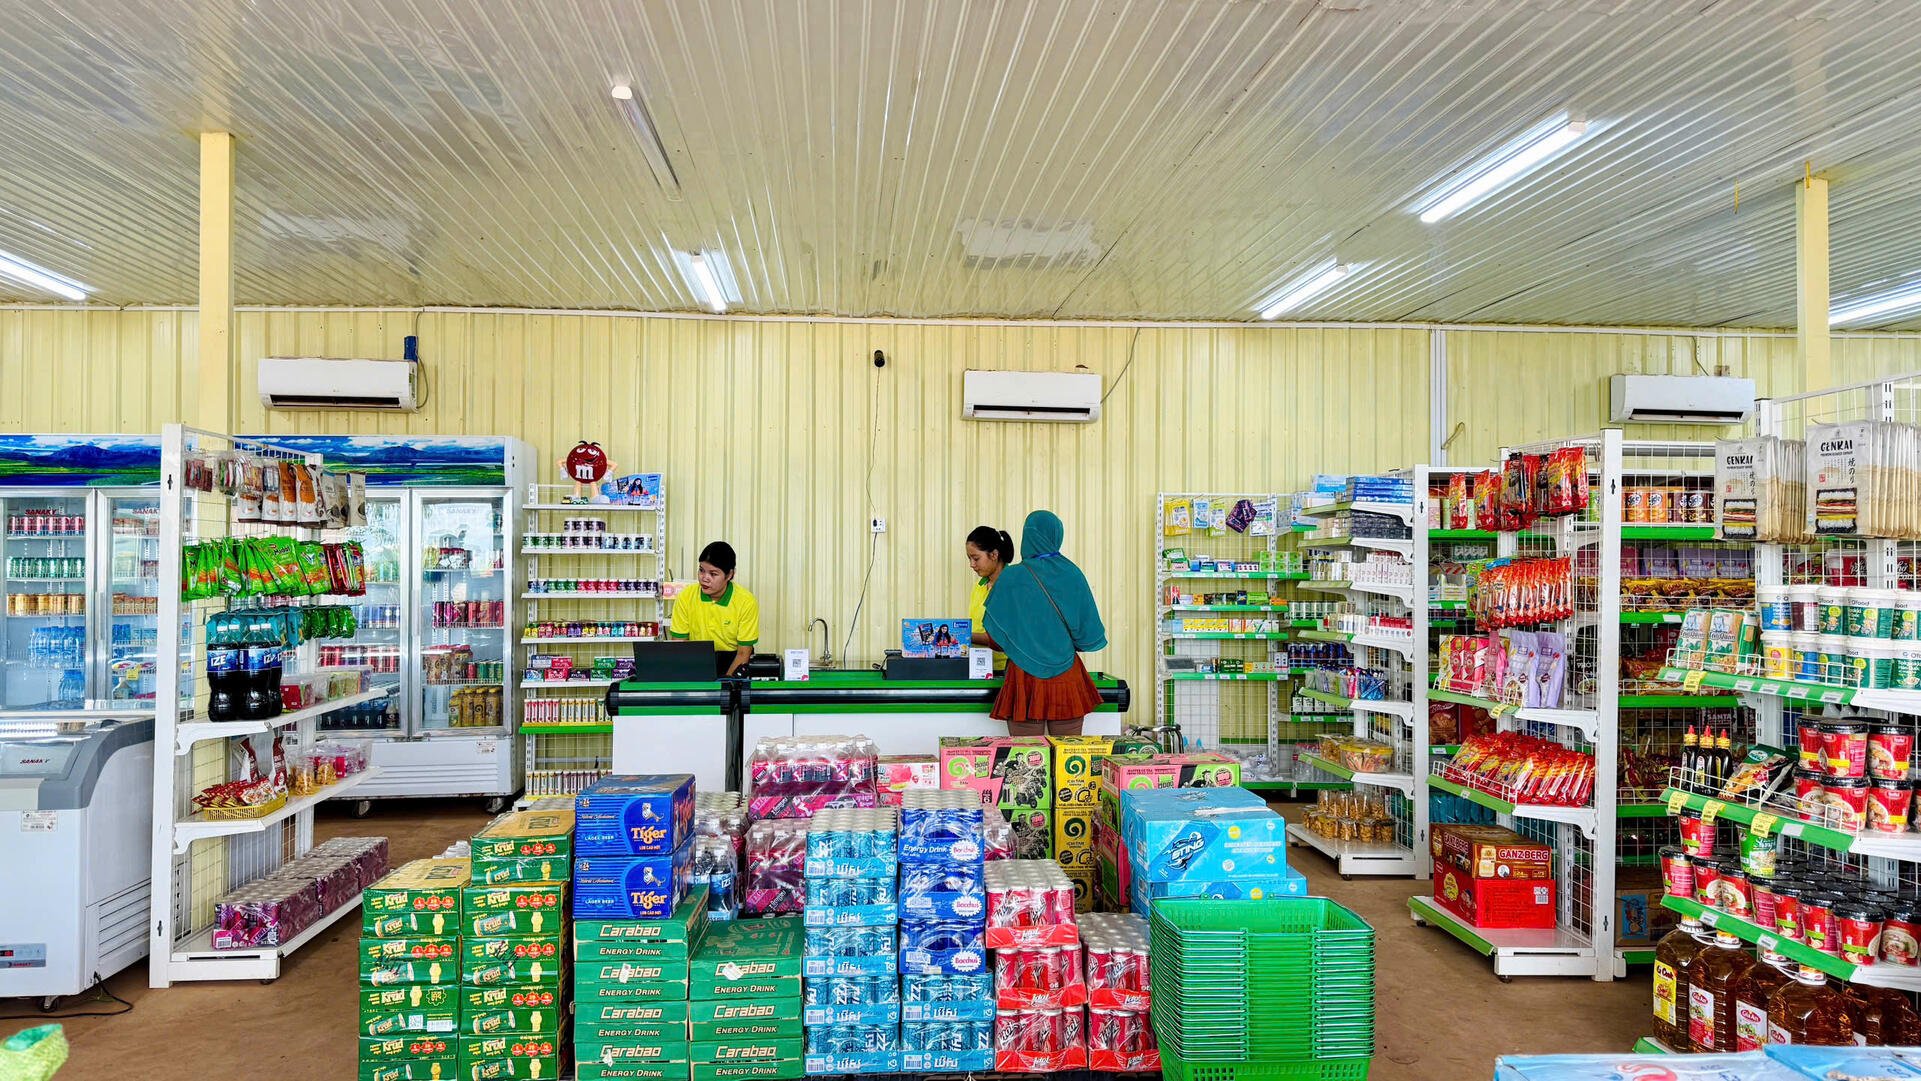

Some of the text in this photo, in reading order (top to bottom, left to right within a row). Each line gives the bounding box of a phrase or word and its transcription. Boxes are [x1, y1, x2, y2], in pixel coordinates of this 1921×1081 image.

[1820, 439, 1853, 452] GENKAI
[1726, 455, 1754, 465] GENKAI
[575, 463, 594, 480] m
[132, 507, 160, 515] SANAK
[631, 825, 667, 844] Tiger
[903, 844, 928, 854] Energy
[1171, 839, 1205, 861] STING
[1499, 849, 1549, 860] GANZBERG
[631, 891, 667, 910] Tiger
[599, 924, 662, 937] Carabao
[600, 947, 662, 956] ENERGY DRINK
[600, 966, 662, 979] Caabao
[599, 988, 661, 996] ENERGY DRINK
[714, 984, 776, 994] ENERGY DRINK
[600, 1006, 662, 1019] Carabao
[714, 1003, 775, 1018] Carabao
[598, 1028, 660, 1037] ENERGY DRINK
[715, 1025, 777, 1035] ENERGY DRINK
[599, 1044, 662, 1058] Carabao
[715, 1045, 777, 1059] Carabao
[600, 1069, 663, 1077] ENERGY DRINK
[715, 1066, 778, 1076] ENERGY DRINK
